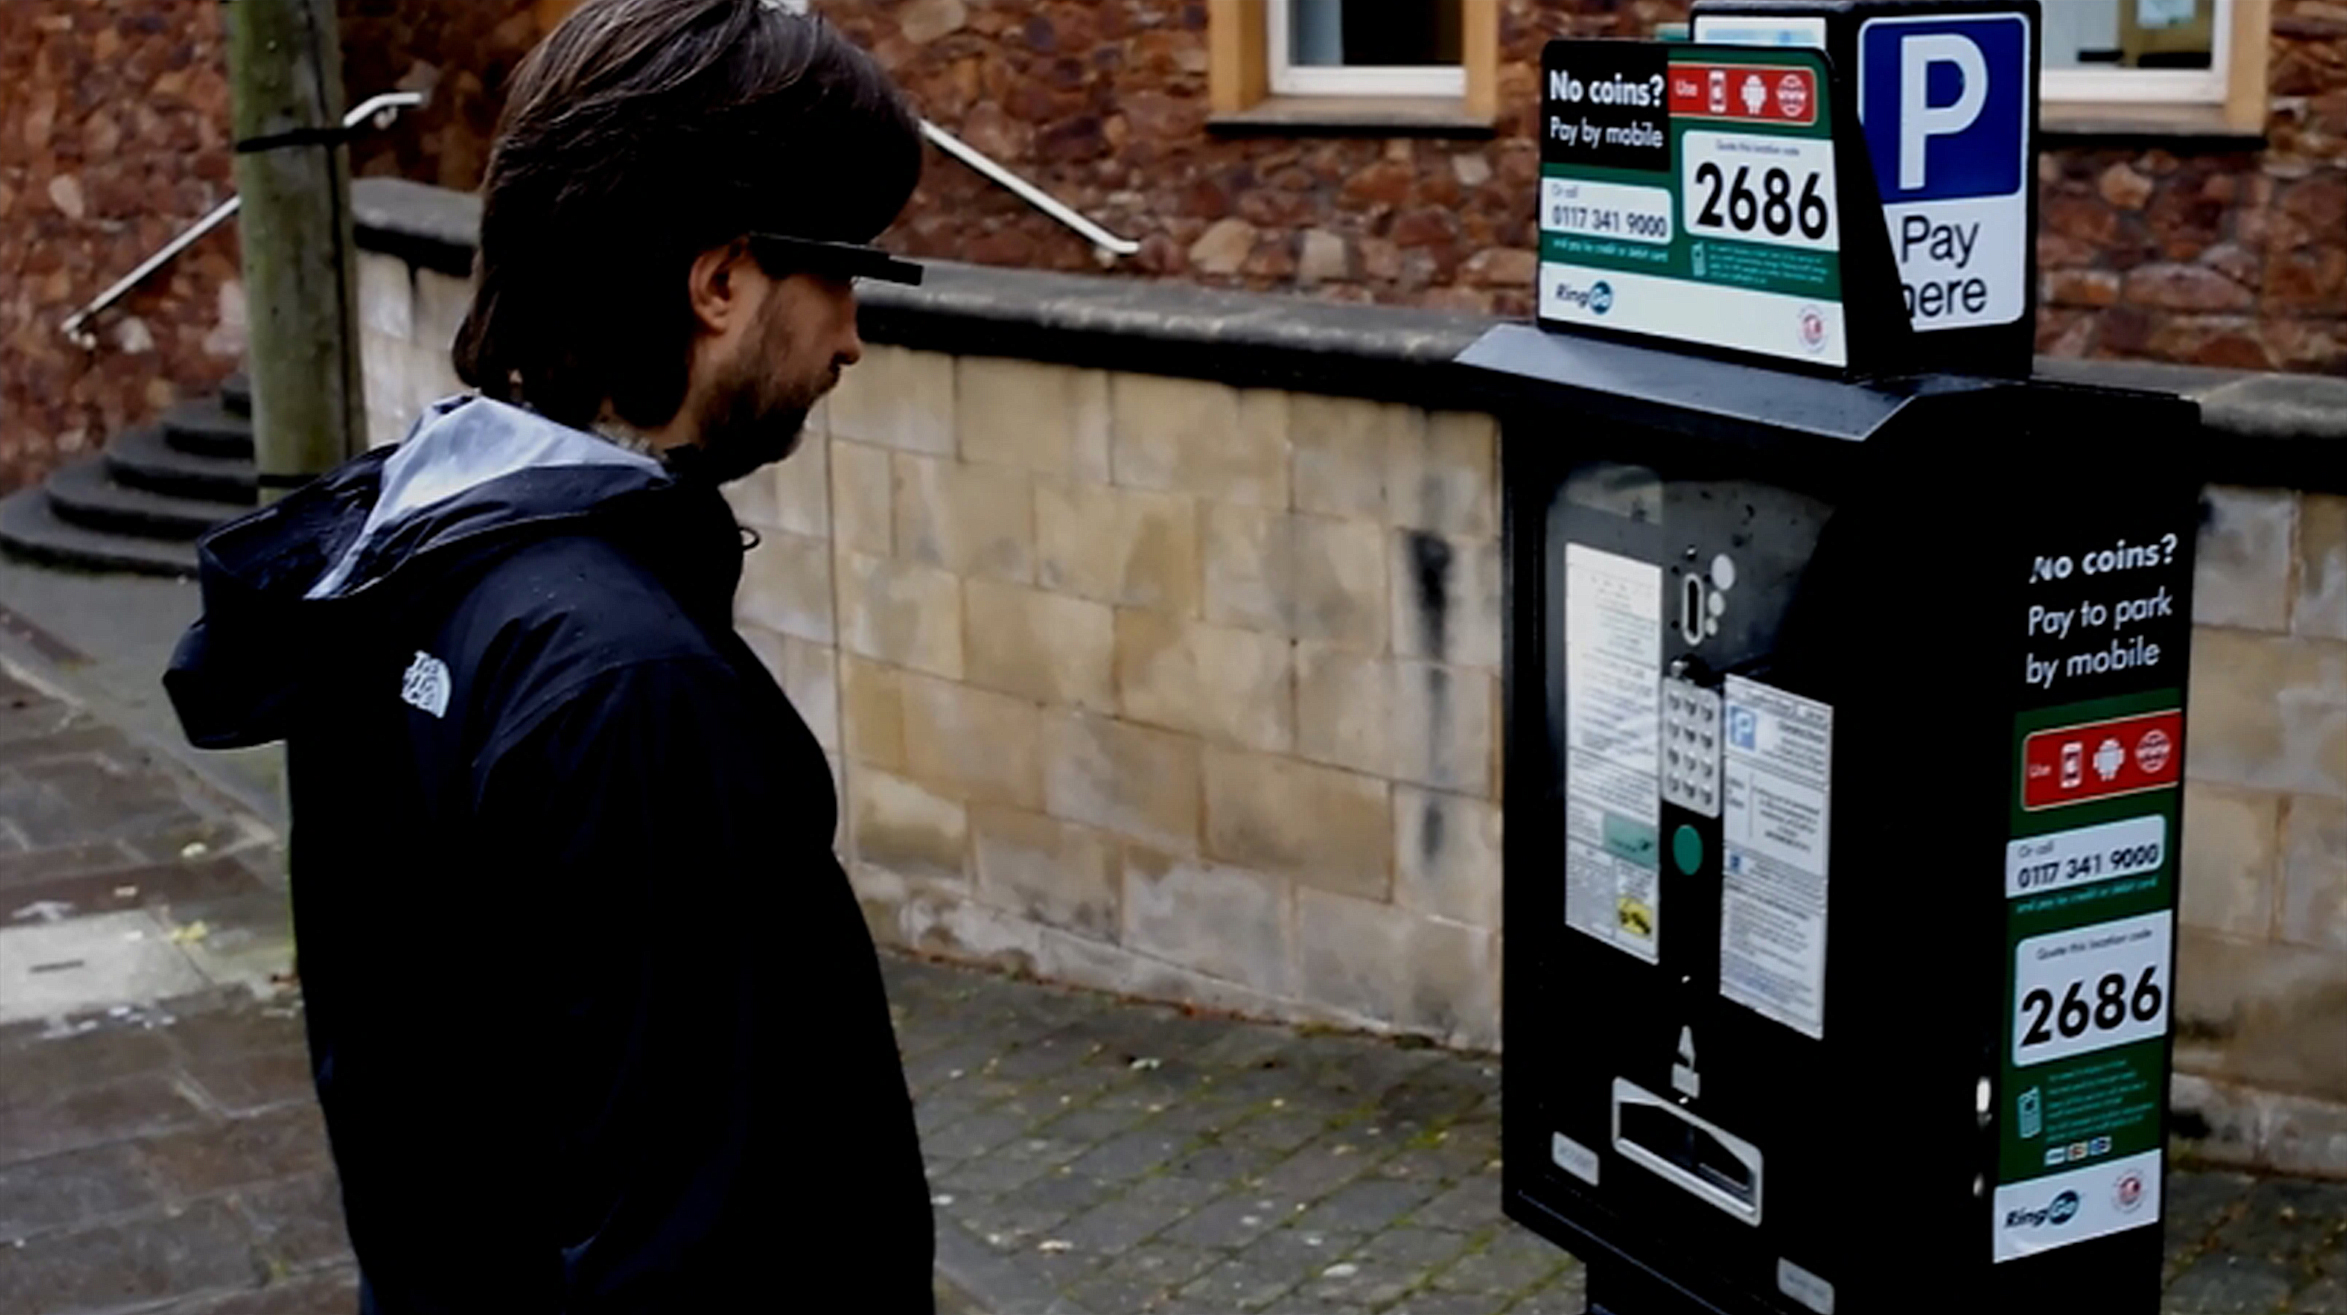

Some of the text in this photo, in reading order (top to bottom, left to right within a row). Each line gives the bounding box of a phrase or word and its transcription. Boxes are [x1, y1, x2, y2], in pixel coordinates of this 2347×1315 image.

[1550, 69, 1665, 107] No coins?
[1900, 33, 1989, 190] P
[1550, 116, 1664, 149] Pay by mobile
[1552, 205, 1668, 238] 0117 341 9000
[1694, 161, 1828, 240] 2686
[1902, 214, 1980, 270] Pay
[2028, 532, 2178, 584] No coins?
[2028, 585, 2173, 640] Pay to park
[2025, 635, 2161, 690] by mobile
[2018, 842, 2159, 888] 0117 341 9000
[2021, 964, 2162, 1048] 2686
